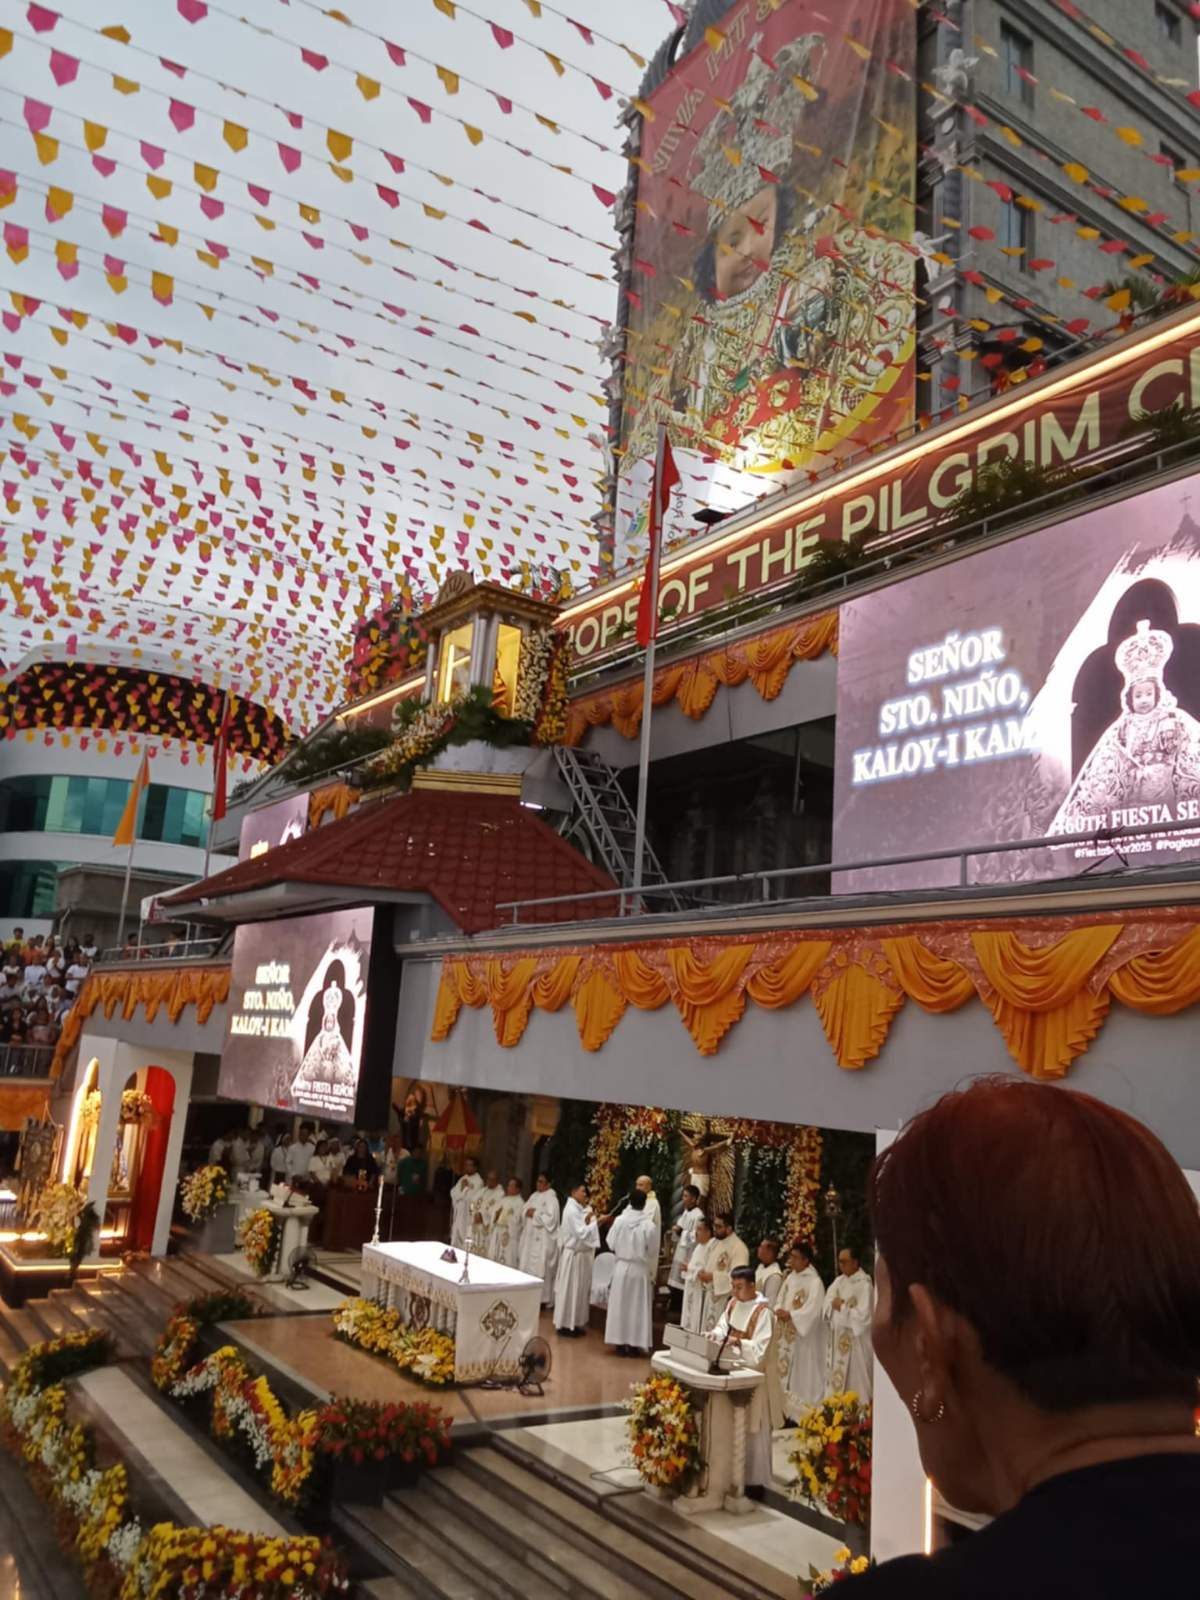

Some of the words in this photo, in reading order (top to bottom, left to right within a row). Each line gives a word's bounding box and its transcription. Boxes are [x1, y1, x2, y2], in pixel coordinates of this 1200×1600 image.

[568, 595, 640, 656] OPE
[658, 563, 714, 622] OF
[727, 513, 826, 592] THE
[842, 391, 1100, 544] PILGRIM
[1129, 346, 1200, 421] C
[907, 628, 1006, 684] SEÑOR
[879, 695, 938, 734] STO.
[942, 670, 1029, 719] NIÑO,
[852, 732, 960, 783] KALOY-I
[1111, 804, 1173, 828] FIESTA
